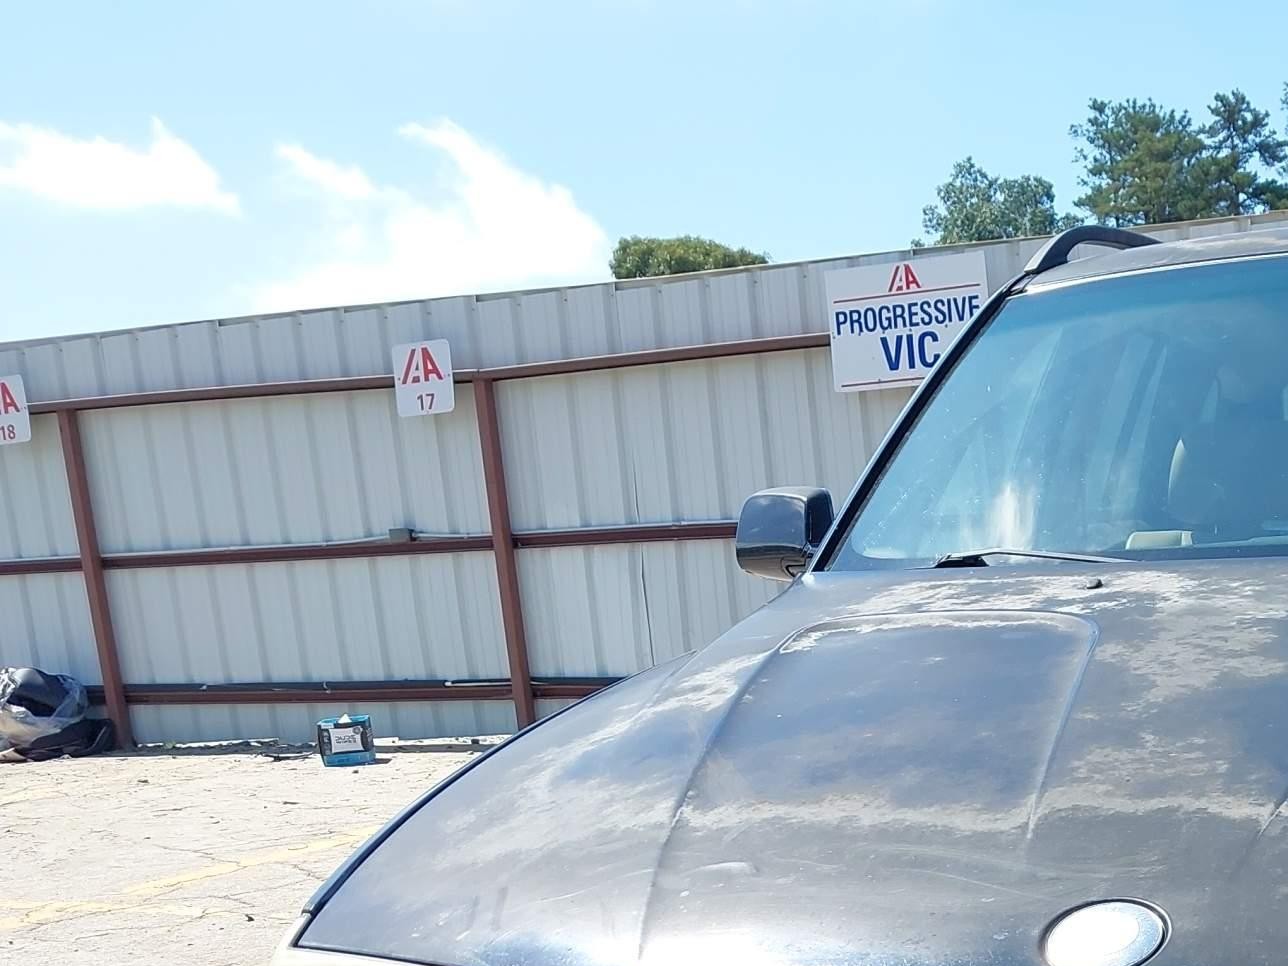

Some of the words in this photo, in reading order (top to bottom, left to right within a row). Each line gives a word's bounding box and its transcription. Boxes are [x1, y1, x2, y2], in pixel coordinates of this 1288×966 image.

[834, 295, 981, 336] PROGRESSIVE
[880, 331, 941, 371] VIC
[416, 393, 435, 411] 17
[0, 424, 16, 440] 18
